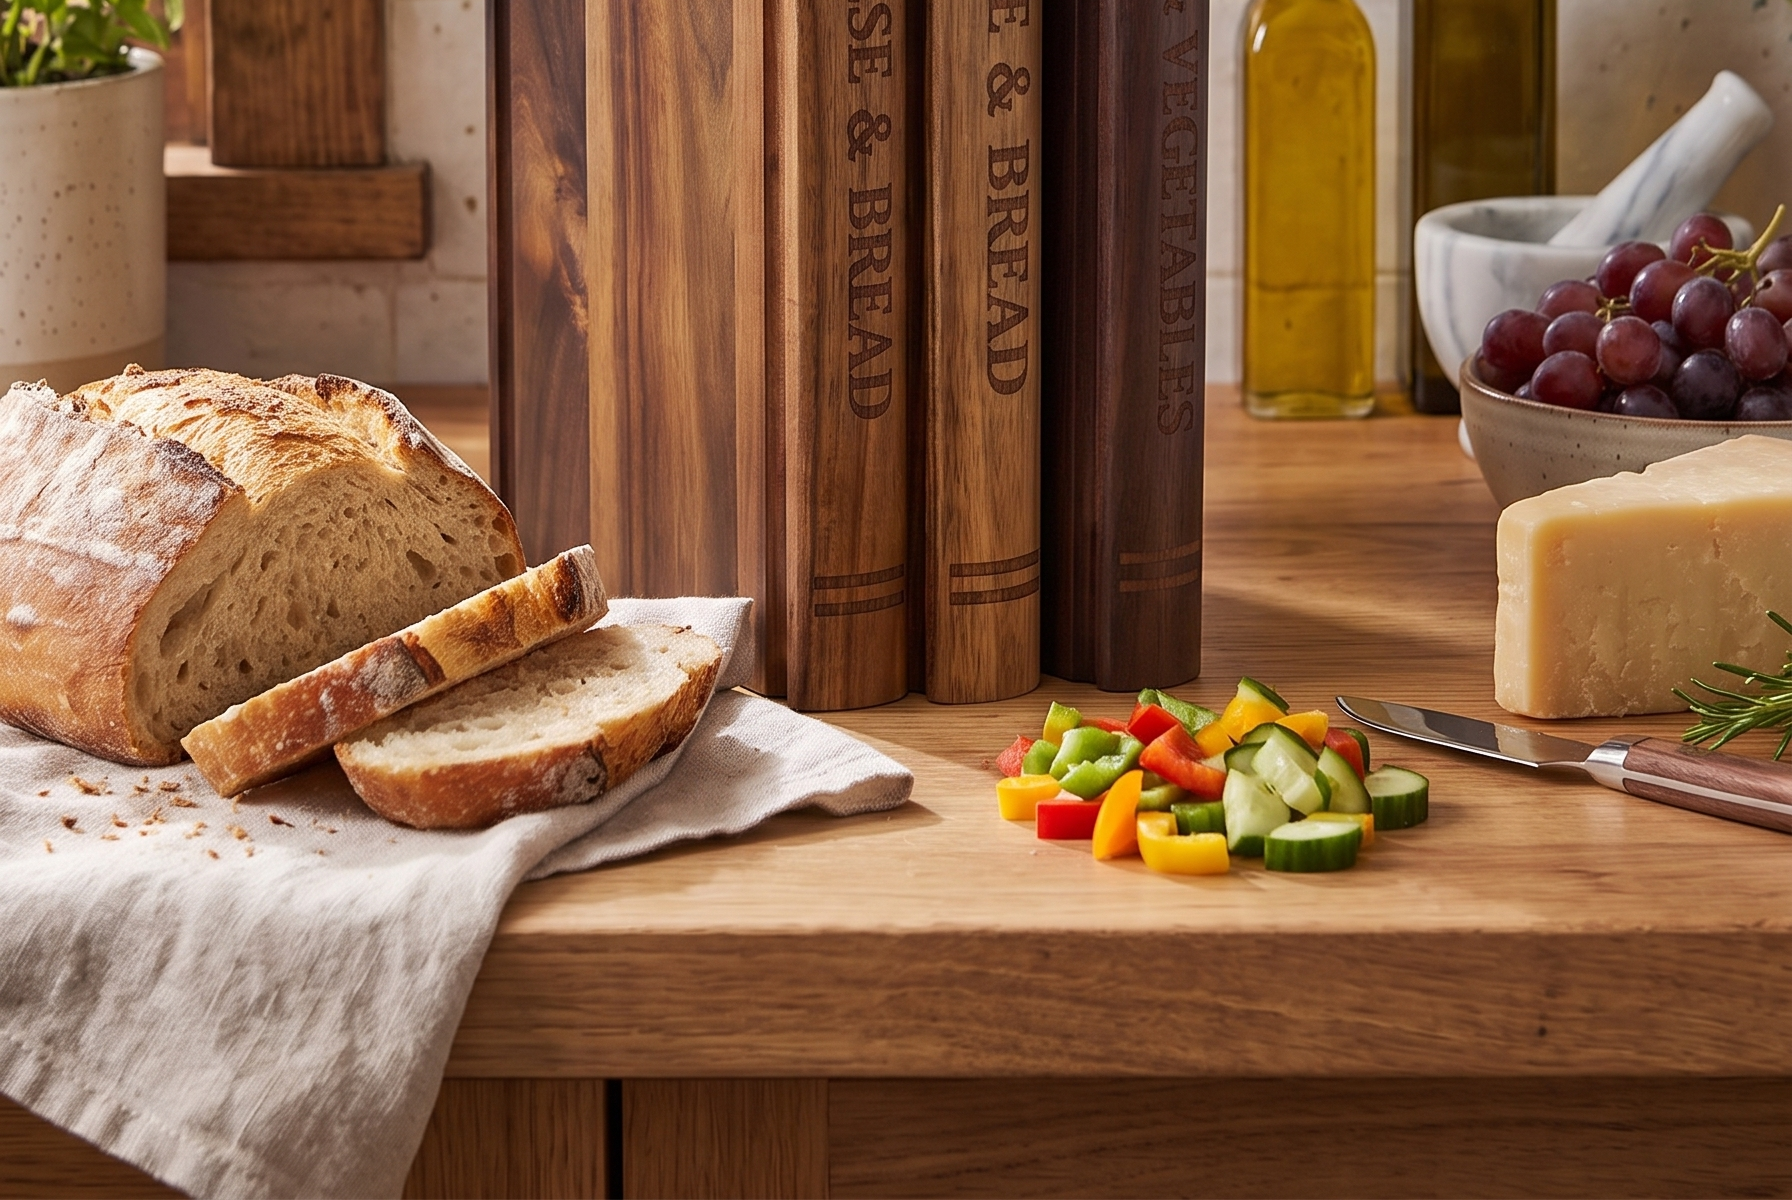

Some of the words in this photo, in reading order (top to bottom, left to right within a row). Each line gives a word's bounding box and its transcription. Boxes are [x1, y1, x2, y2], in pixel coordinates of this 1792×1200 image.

[847, 109, 892, 162] &
[986, 62, 1031, 118] &
[848, 182, 893, 420] BREAD
[986, 139, 1030, 396] BREAD
[1157, 30, 1199, 435] VEGETABLES
